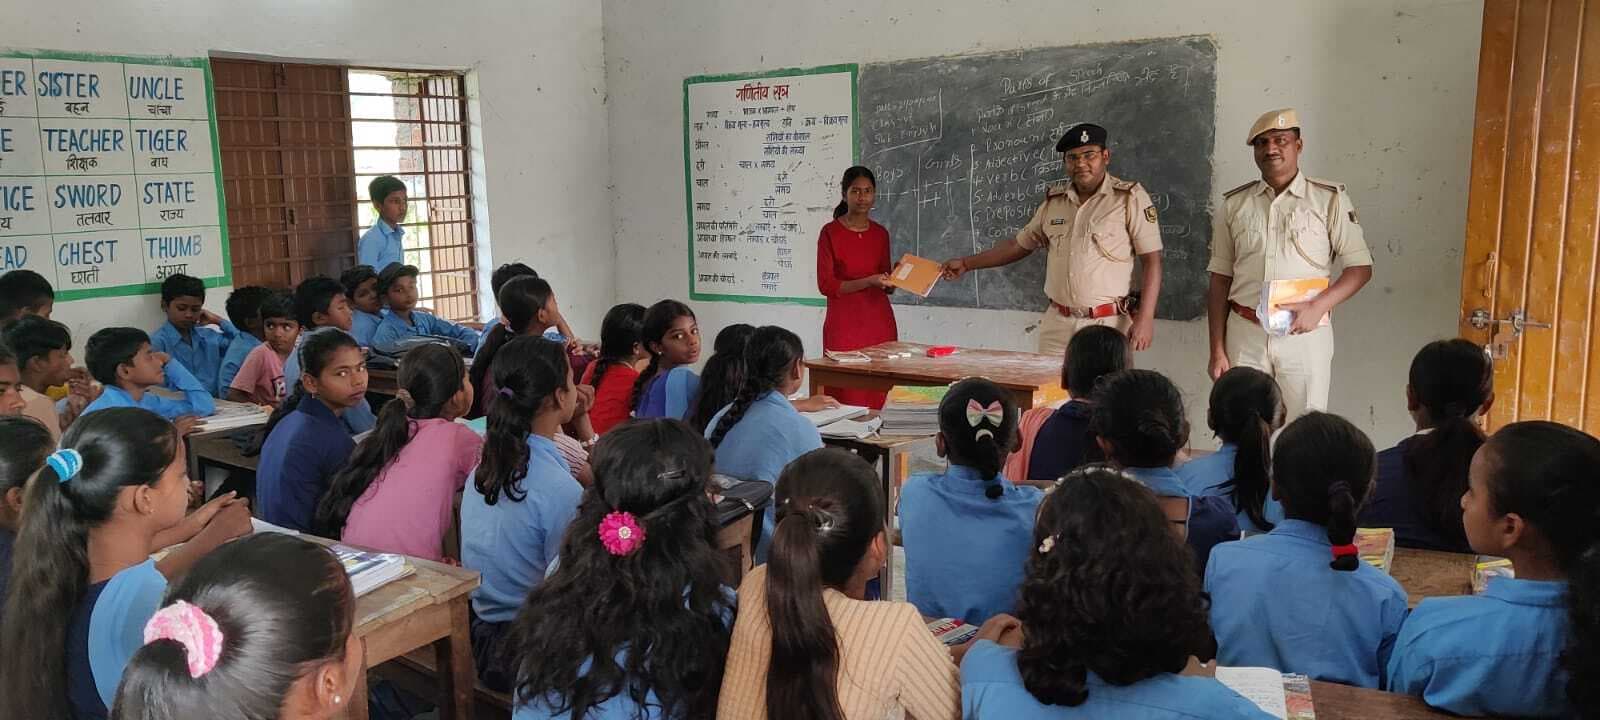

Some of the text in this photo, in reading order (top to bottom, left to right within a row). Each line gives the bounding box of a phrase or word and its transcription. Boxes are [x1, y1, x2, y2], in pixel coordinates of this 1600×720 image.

[38, 72, 100, 98] SISTER
[130, 76, 184, 100] UNCLE
[736, 82, 770, 101] गणितीय
[64, 102, 90, 115] बहन
[147, 104, 172, 116] चाचा
[42, 128, 124, 152] TEACHER
[136, 129, 188, 152] TIGER
[66, 154, 98, 171] शिक्षक
[0, 185, 34, 211] ICE
[55, 183, 121, 208] SWORD
[143, 181, 195, 204] STATE
[76, 211, 114, 227] तलवार
[160, 208, 184, 220] राज्य
[59, 239, 118, 266] CHEST
[145, 234, 202, 259] THUMB
[71, 265, 100, 285] छाती
